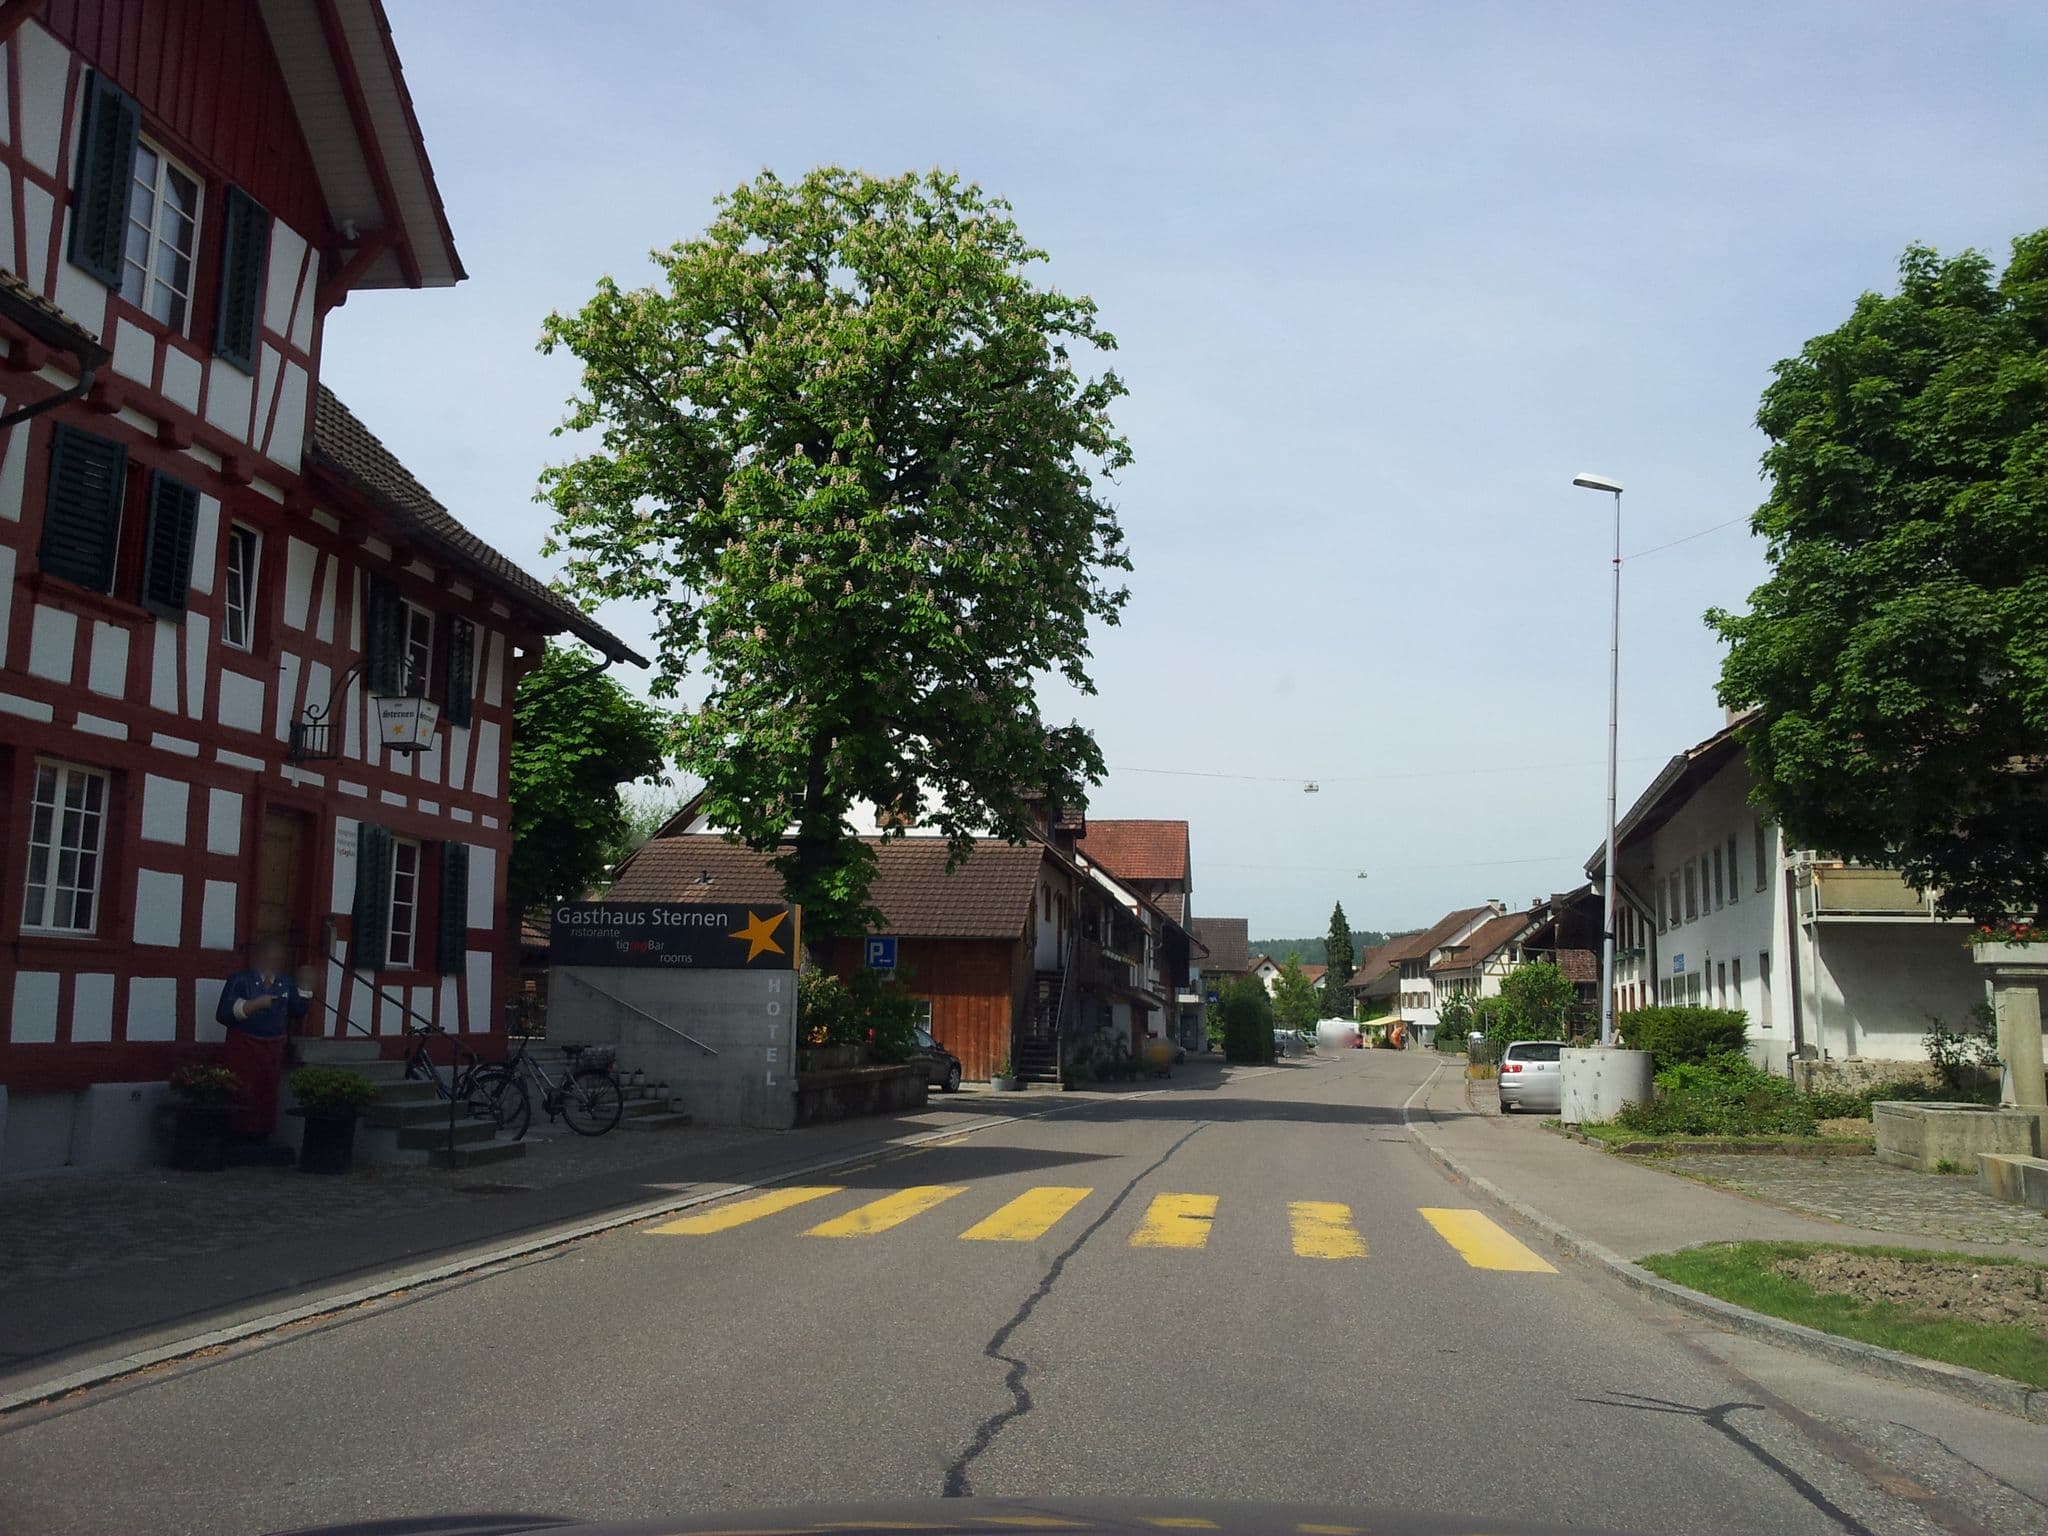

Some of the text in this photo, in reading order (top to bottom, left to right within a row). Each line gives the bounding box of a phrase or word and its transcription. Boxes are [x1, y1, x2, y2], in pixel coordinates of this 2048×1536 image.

[557, 907, 728, 926] Gasthaus Sternen
[571, 927, 620, 937] ristorante
[660, 954, 693, 963] rooms
[870, 942, 883, 963] P
